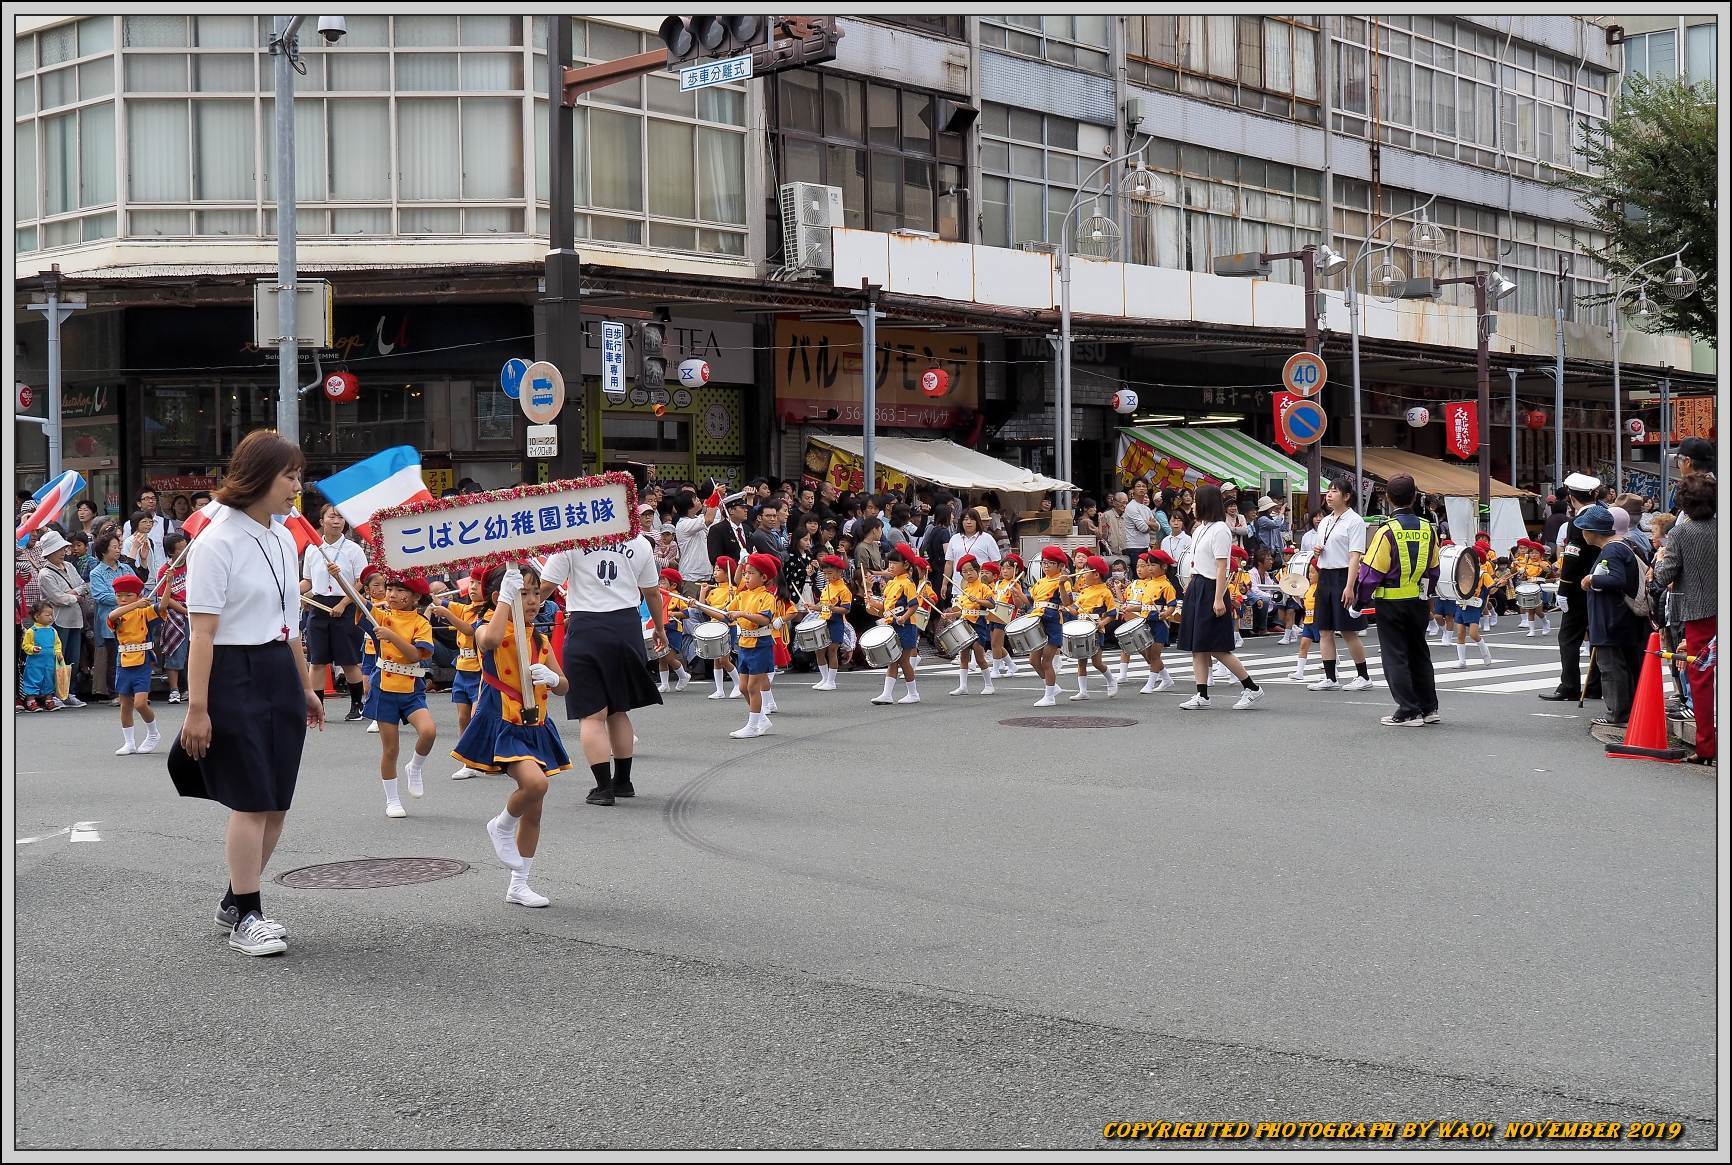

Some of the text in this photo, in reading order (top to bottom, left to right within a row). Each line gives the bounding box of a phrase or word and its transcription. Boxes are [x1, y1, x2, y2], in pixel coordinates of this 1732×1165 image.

[687, 61, 745, 86] 歩車分離式
[605, 328, 614, 362] 自転車
[613, 328, 623, 364] 歩行者
[673, 327, 722, 358] TEA
[610, 364, 619, 387] 専用
[787, 333, 840, 390] バル
[1293, 364, 1317, 384] 40
[401, 497, 616, 555] こばと幼稚園鼓隊
[1396, 531, 1430, 541] DAIDO
